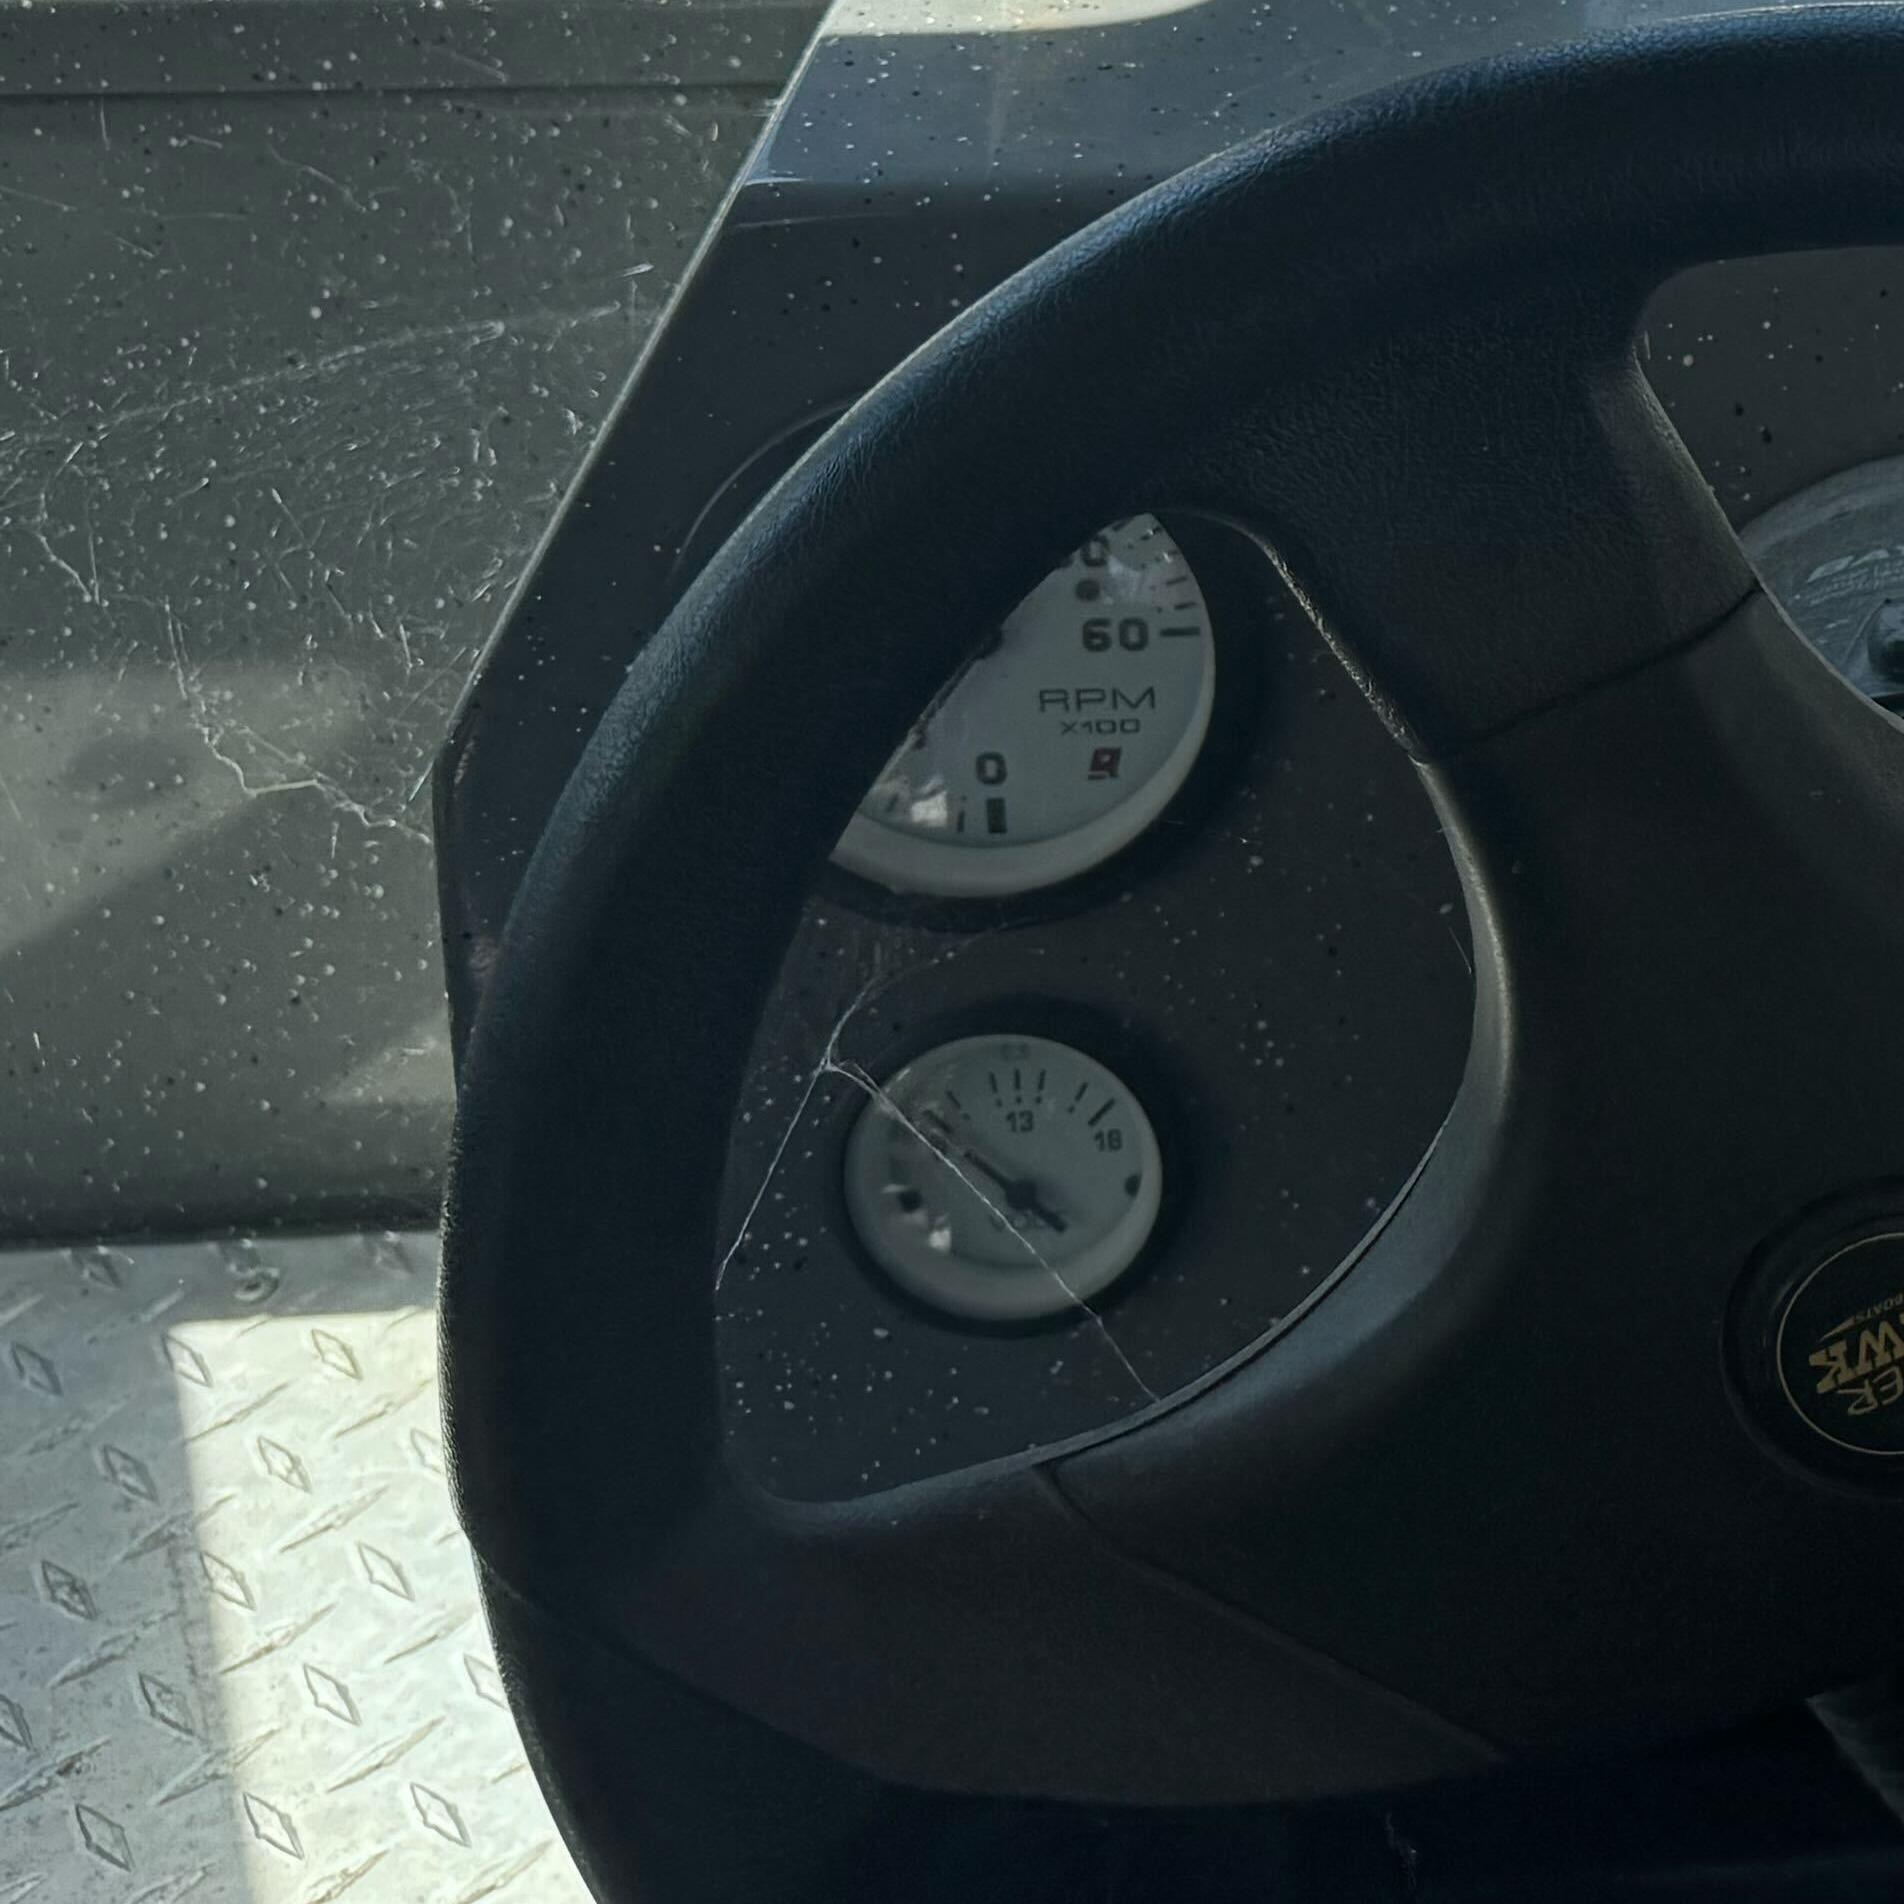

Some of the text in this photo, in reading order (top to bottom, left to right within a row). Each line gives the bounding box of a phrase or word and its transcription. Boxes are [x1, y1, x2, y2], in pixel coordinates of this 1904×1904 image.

[1081, 617, 1151, 653] 60
[1038, 686, 1156, 714] RPM
[975, 751, 1008, 786] 0
[1006, 1110, 1034, 1133] 13
